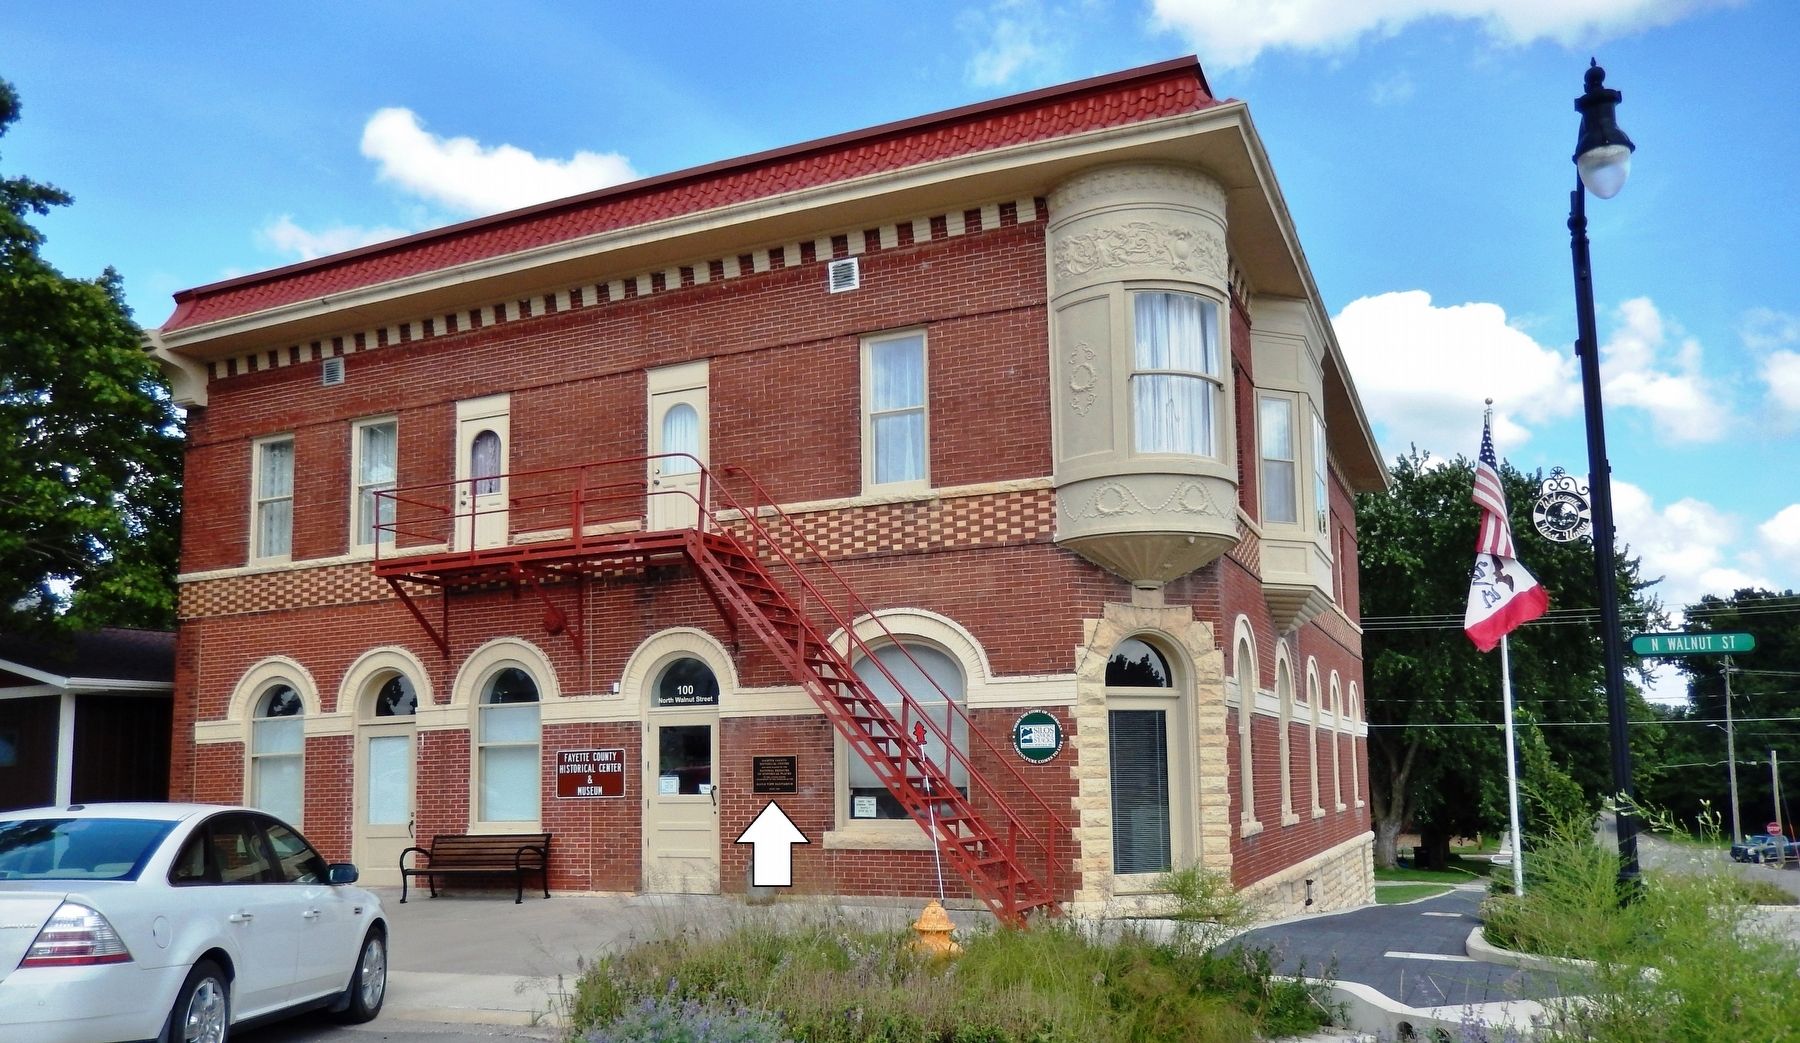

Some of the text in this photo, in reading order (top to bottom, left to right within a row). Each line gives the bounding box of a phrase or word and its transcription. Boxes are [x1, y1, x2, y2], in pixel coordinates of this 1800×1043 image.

[1540, 493, 1581, 508] Welcome
[1651, 636, 1735, 651] N WALNUT ST
[677, 685, 694, 695] 100
[564, 751, 617, 762] FAYETTE COUNTY
[559, 763, 622, 774] HISTORICAL CENTER
[587, 774, 593, 784] &
[577, 785, 603, 796] MUSEUM
